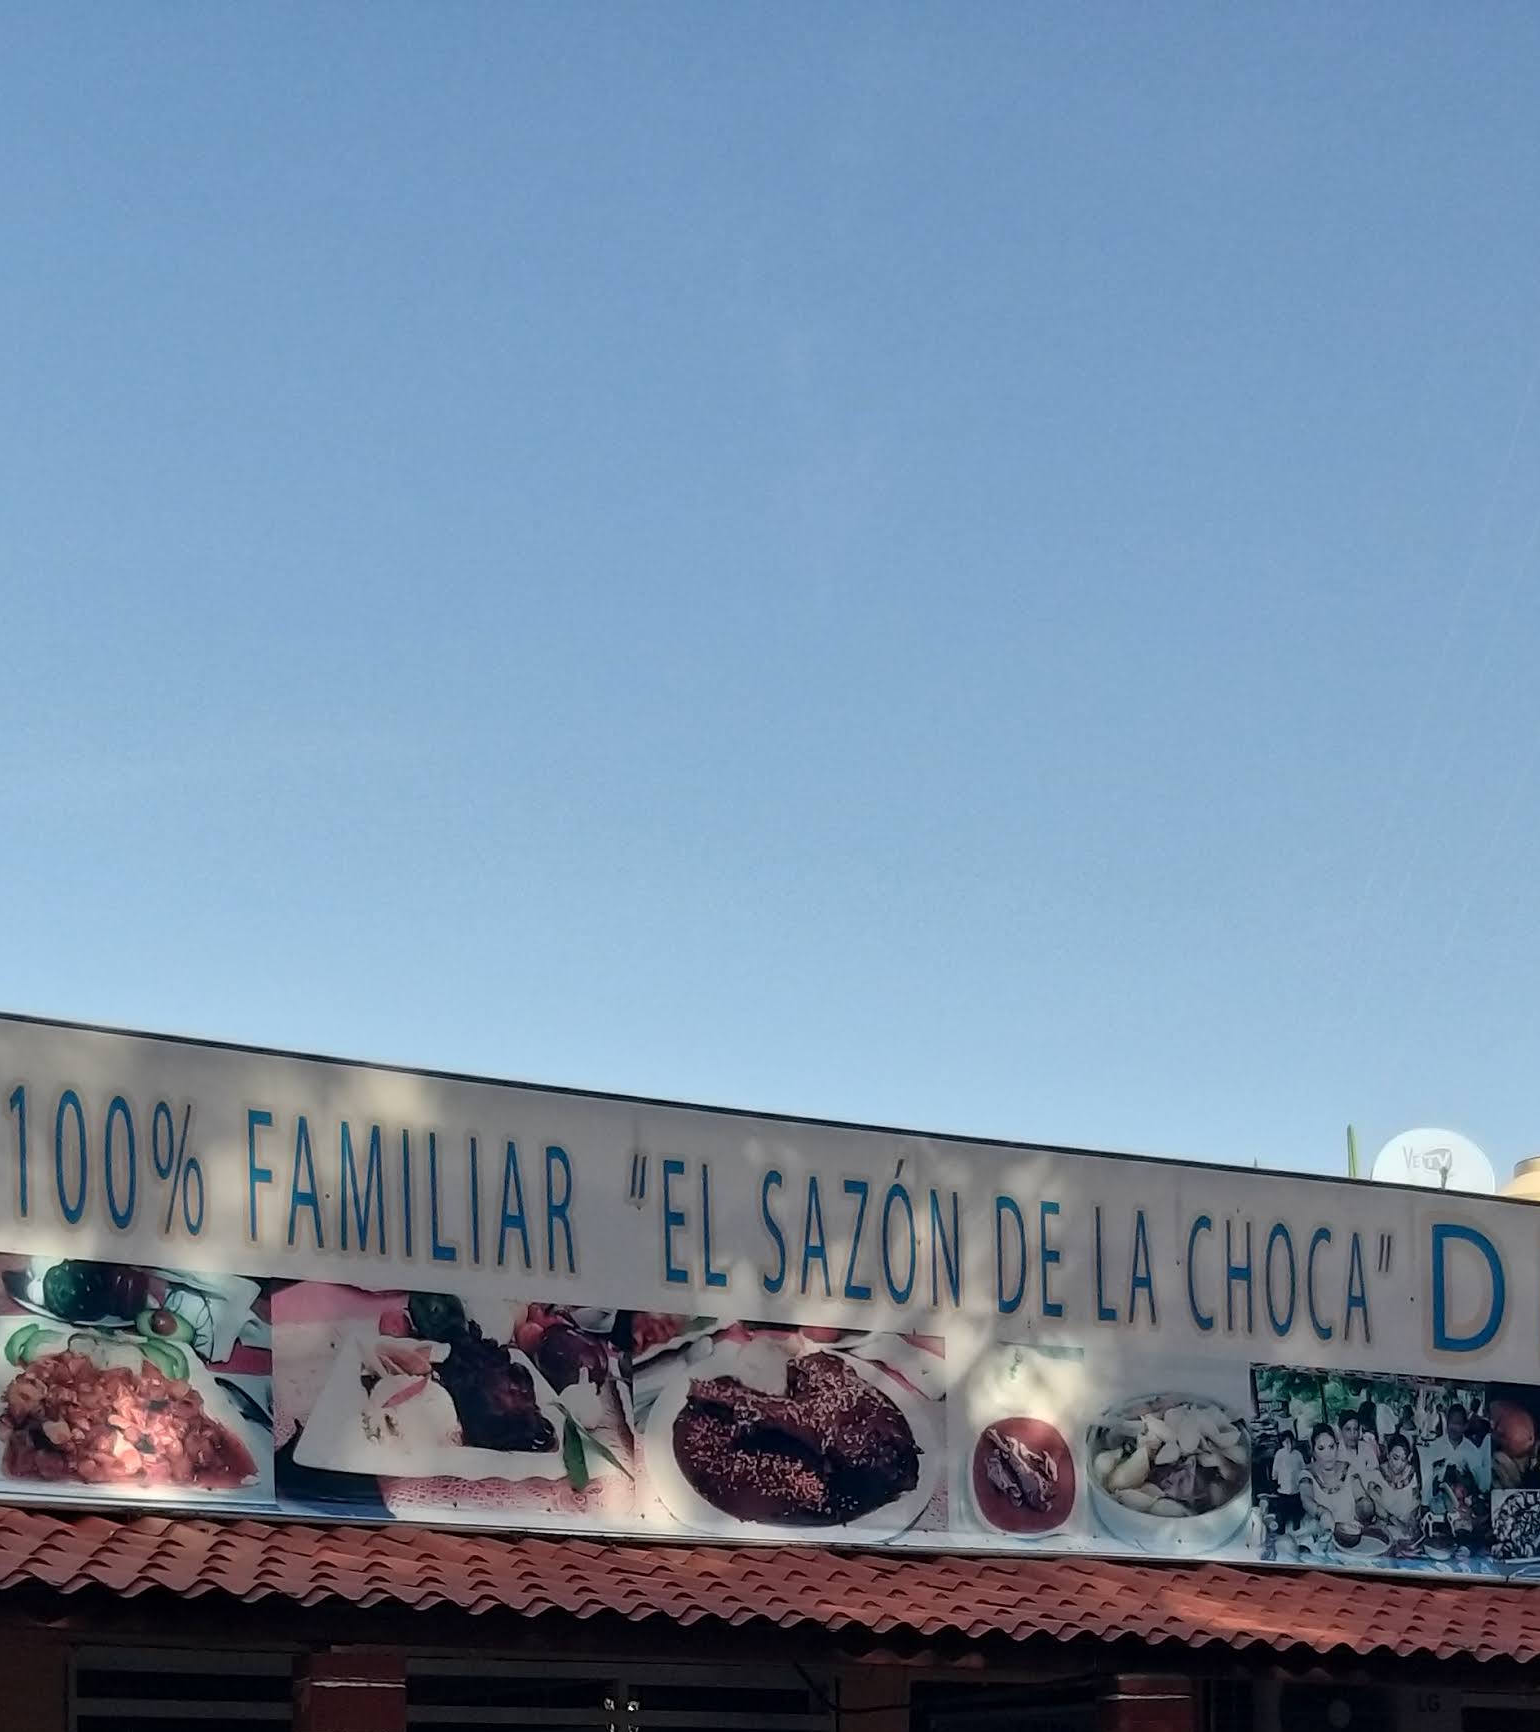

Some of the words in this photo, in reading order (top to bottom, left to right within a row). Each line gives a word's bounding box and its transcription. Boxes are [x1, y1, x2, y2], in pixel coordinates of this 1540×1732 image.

[10, 1084, 205, 1237] 100%
[247, 1108, 576, 1274] FAMILIAR
[762, 1158, 962, 1309] SAZÓN
[996, 1195, 1065, 1318] DE
[1095, 1205, 1159, 1326] LA
[1416, 1692, 1441, 1713] LG
